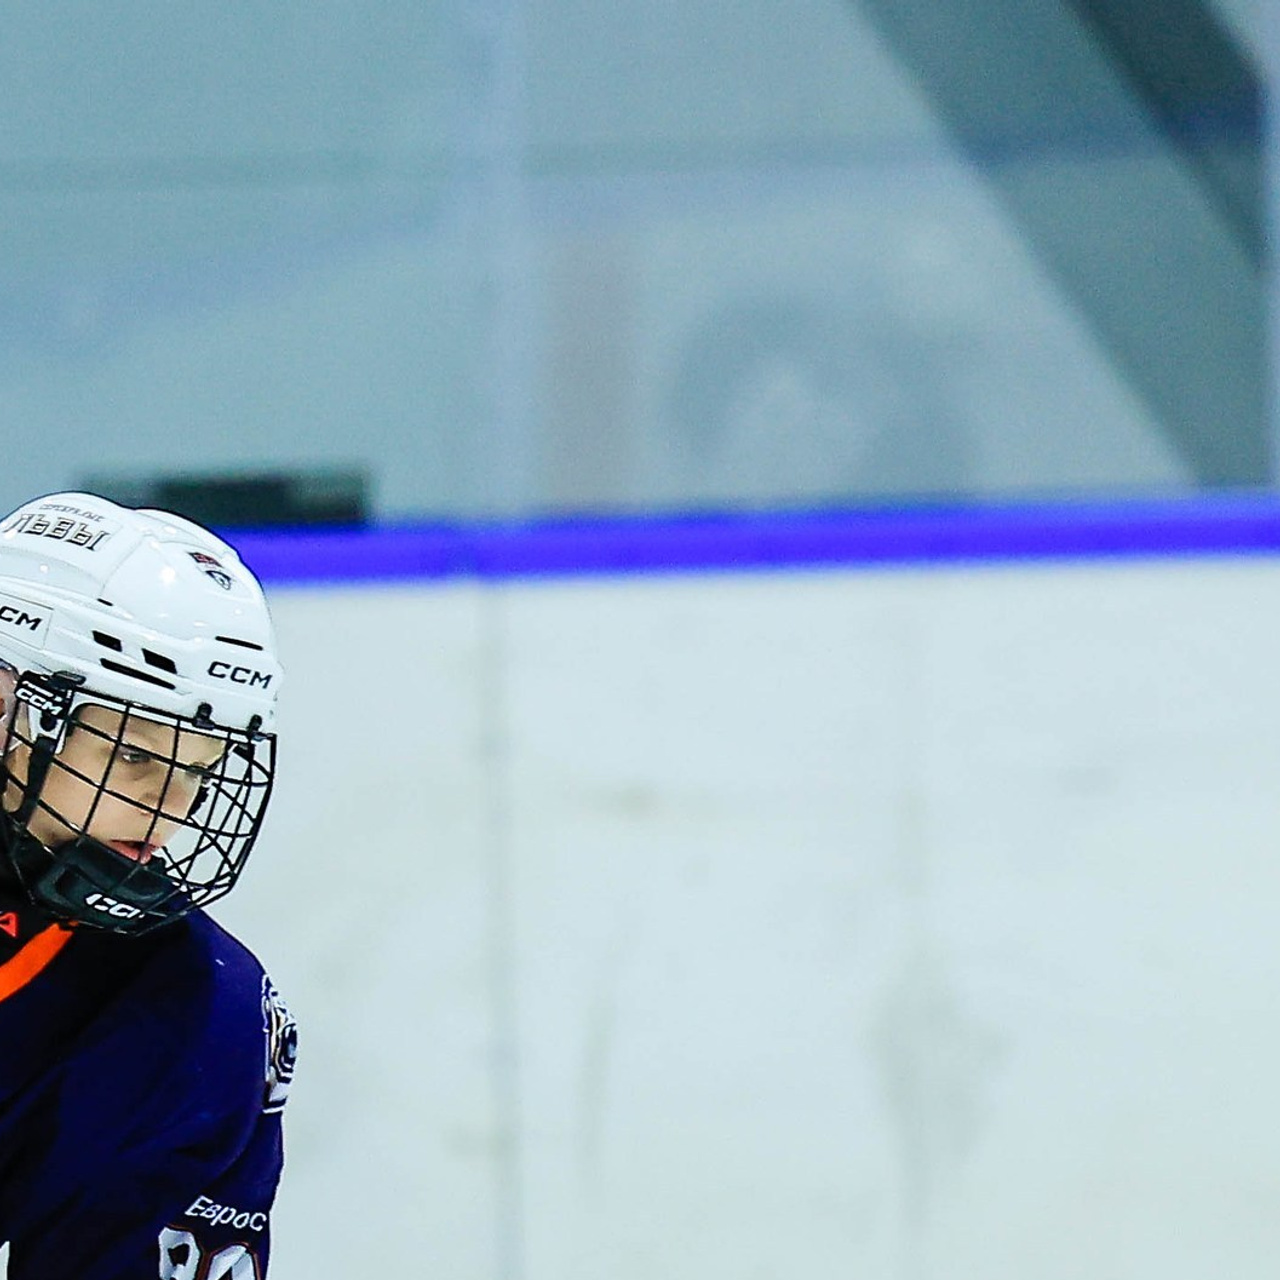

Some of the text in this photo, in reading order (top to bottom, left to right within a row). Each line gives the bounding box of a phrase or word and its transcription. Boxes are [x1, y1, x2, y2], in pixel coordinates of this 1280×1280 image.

[3, 513, 111, 552] ЛЬВЫ
[207, 660, 273, 689] CCM
[15, 686, 63, 716] CCM
